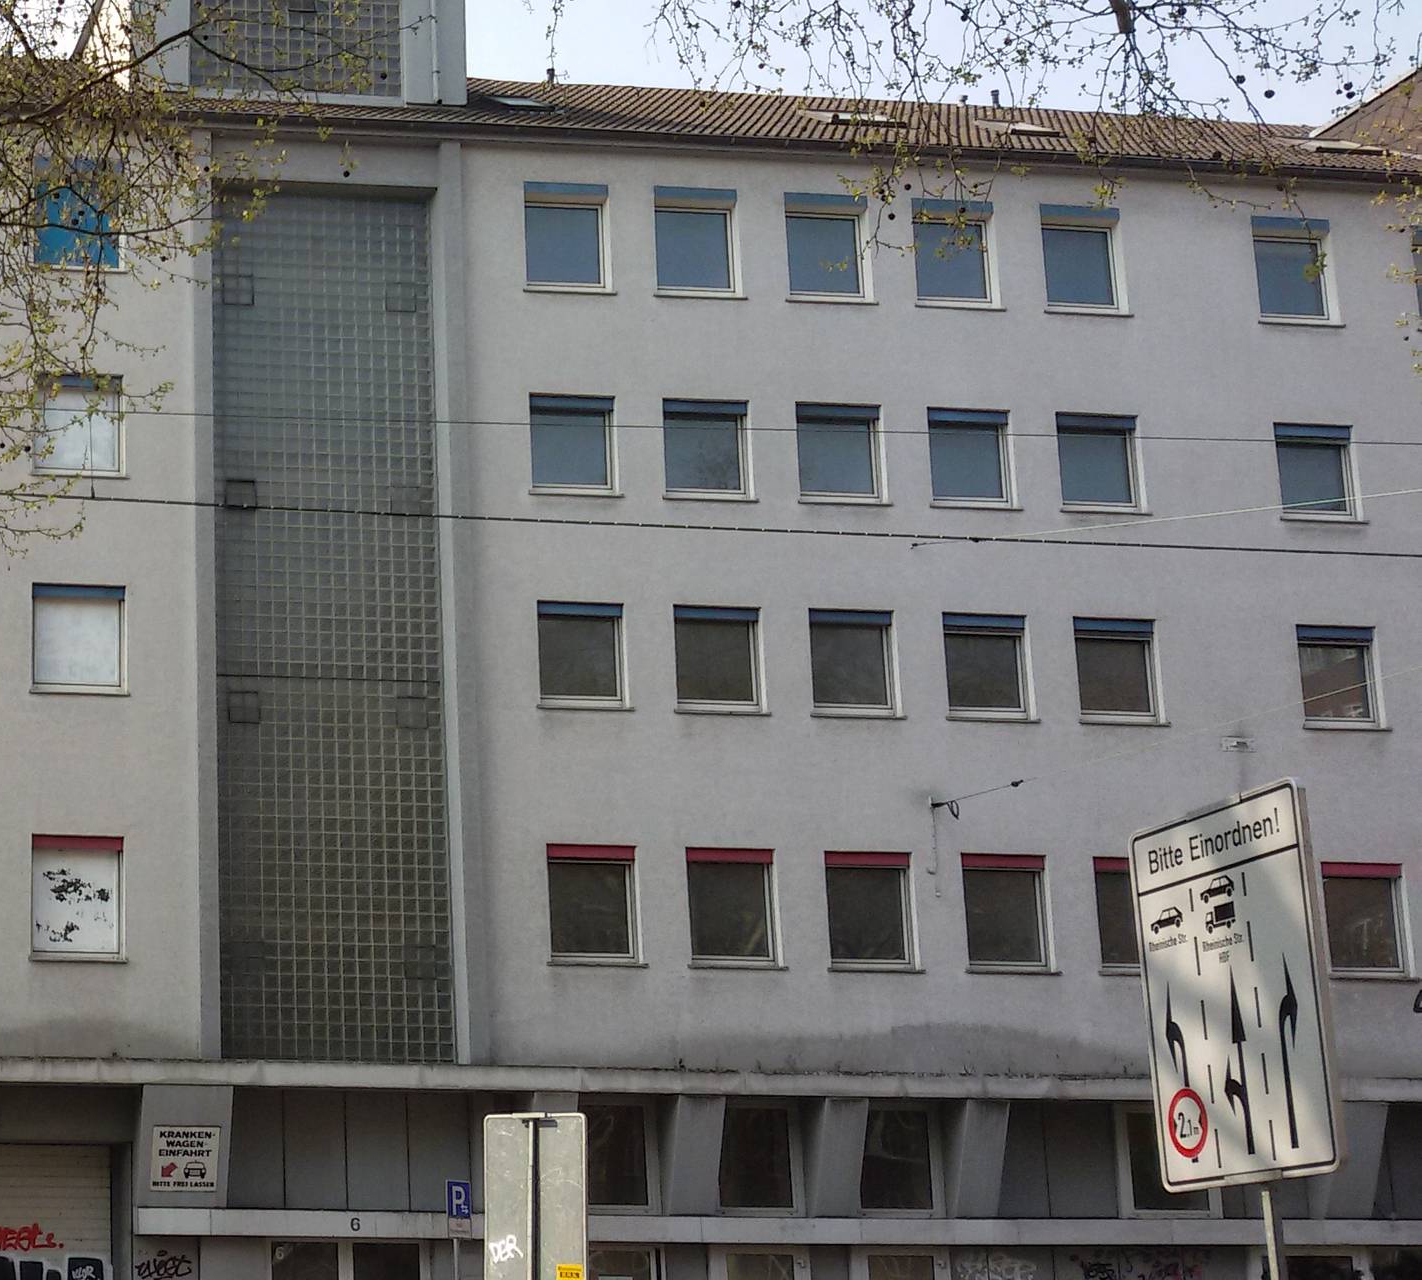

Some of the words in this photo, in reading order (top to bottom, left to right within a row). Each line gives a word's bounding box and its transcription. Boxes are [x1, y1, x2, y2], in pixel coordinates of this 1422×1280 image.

[1148, 846, 1183, 875] Bitte
[1189, 807, 1280, 861] Einordnen!
[159, 1130, 215, 1139] KRANKEN-
[158, 1149, 212, 1157] EINFAHRT
[452, 1185, 465, 1216] P
[351, 1217, 361, 1232] 6
[275, 1246, 285, 1260] 6
